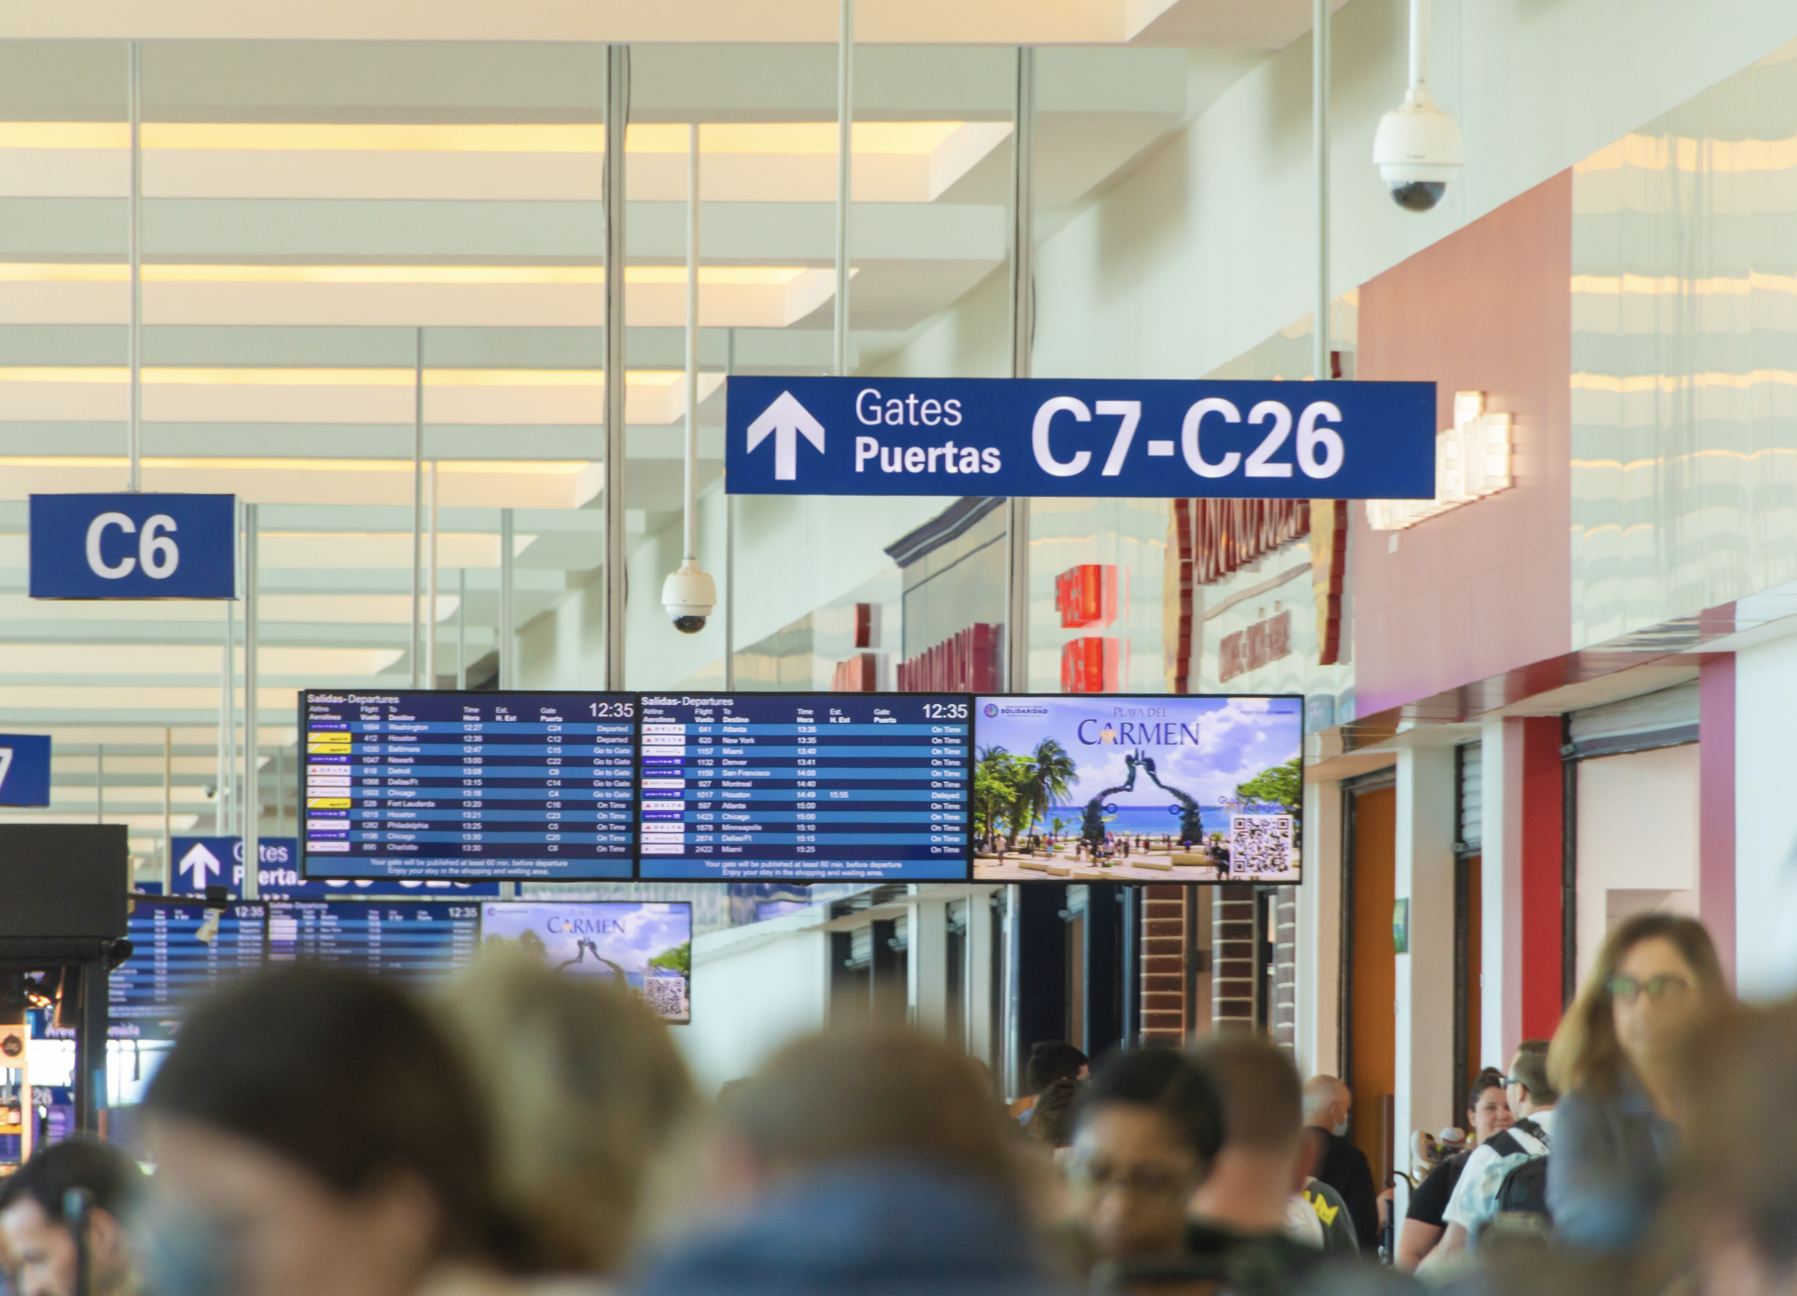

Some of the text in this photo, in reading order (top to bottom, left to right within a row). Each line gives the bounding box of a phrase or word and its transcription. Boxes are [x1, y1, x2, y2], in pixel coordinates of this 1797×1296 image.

[855, 388, 963, 426] Gates
[1031, 396, 1345, 479] C7-C26
[855, 435, 1001, 474] Puertas
[85, 512, 180, 579] C6
[360, 704, 379, 713] Flight
[590, 703, 633, 717] 12:35
[694, 708, 713, 716] Flight
[923, 704, 968, 718] 12:35
[1113, 706, 1168, 718] PLAYA DEL
[388, 724, 429, 733] Washington
[596, 725, 628, 734] Departed
[1077, 718, 1200, 746] CARMEN
[596, 736, 629, 745] Departed
[387, 789, 416, 798] Chicago
[931, 792, 960, 801] Delayed
[721, 813, 751, 822] Chicago
[387, 821, 429, 831] Philadelphia
[721, 824, 762, 833] Minneapolis
[386, 832, 416, 842] Chicago
[232, 864, 308, 886] Perta
[234, 906, 265, 918] 12:35
[449, 907, 478, 918] 12:35
[546, 916, 626, 934] CARMEN
